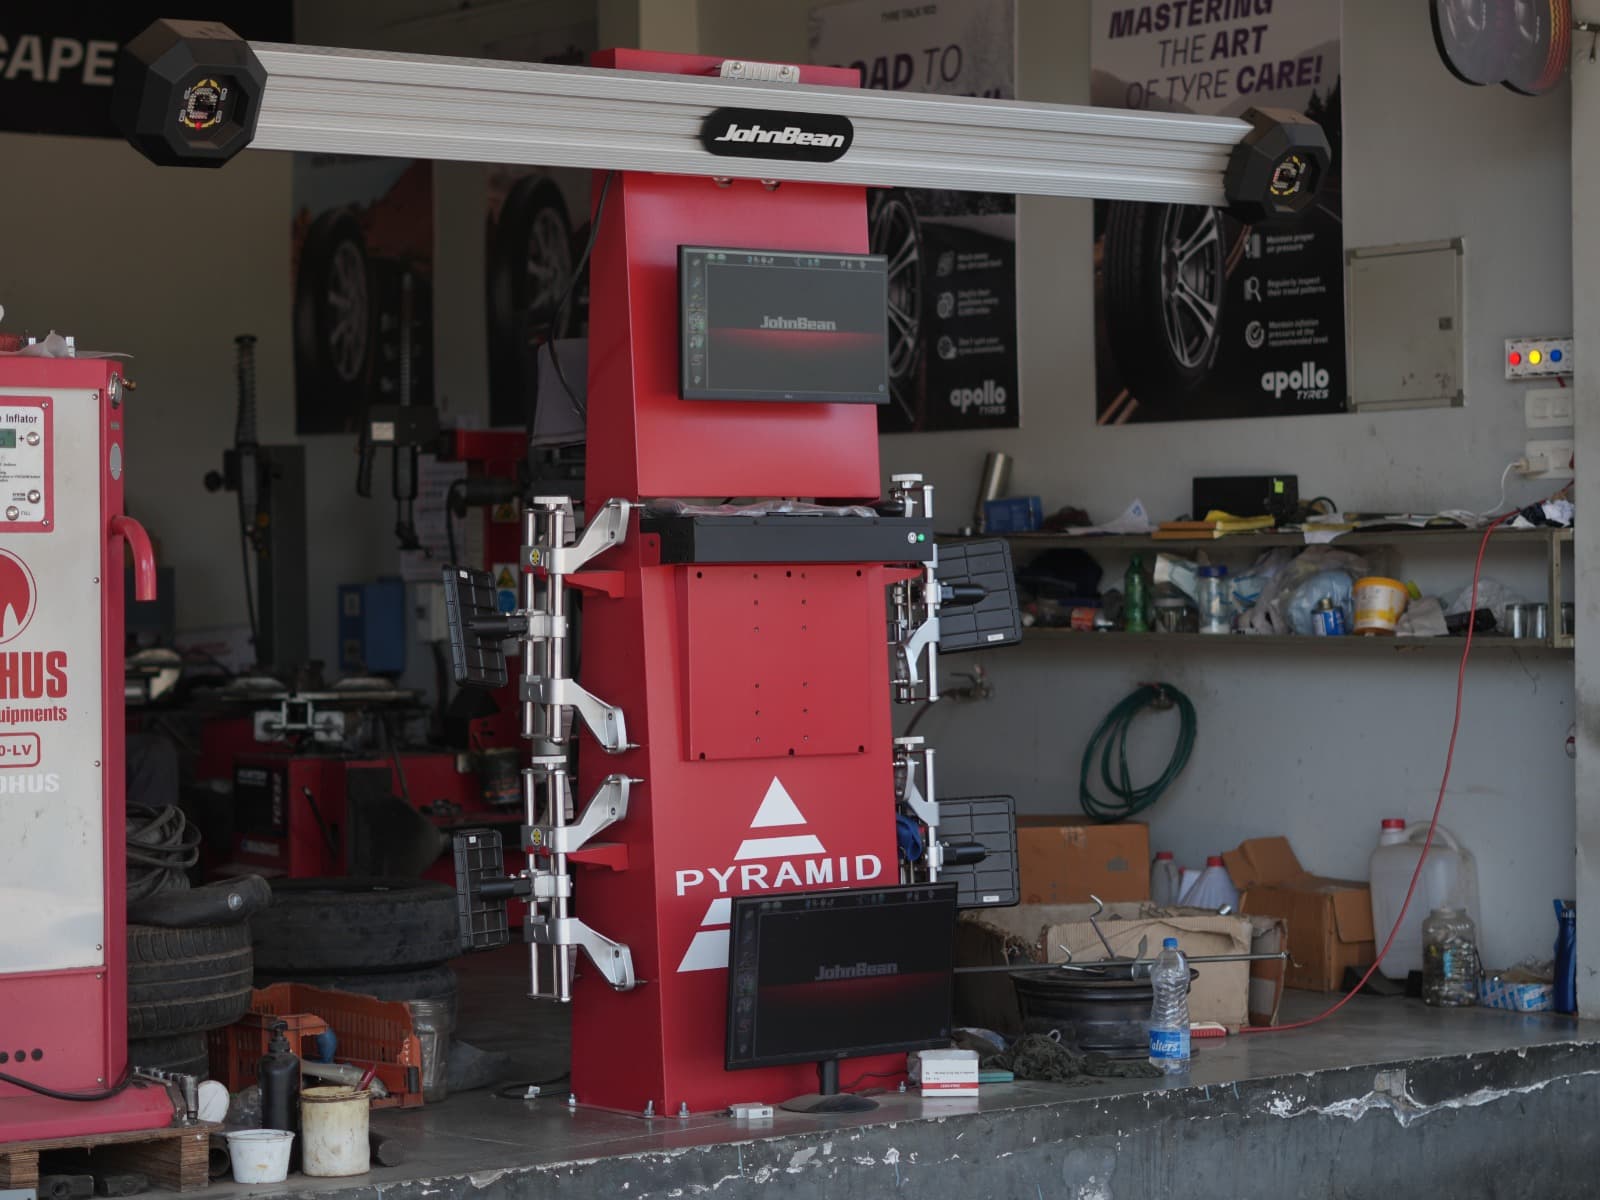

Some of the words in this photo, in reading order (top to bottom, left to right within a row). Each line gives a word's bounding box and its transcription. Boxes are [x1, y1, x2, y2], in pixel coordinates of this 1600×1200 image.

[0, 33, 118, 86] APE
[924, 44, 962, 85] TO
[1159, 34, 1207, 68] THE
[1210, 25, 1268, 60] ART
[1126, 79, 1159, 109] OF
[1166, 69, 1230, 104] TYRE
[1237, 56, 1323, 94] CARE!
[714, 123, 845, 148] JohnBean
[760, 315, 837, 331] JohnBean
[950, 379, 1006, 414] apollo
[1261, 361, 1330, 399] apollo
[1297, 389, 1329, 400] TYRES
[6, 414, 38, 424] Inflator
[675, 854, 883, 897] PYRAMID
[815, 961, 899, 981] JohnBean
